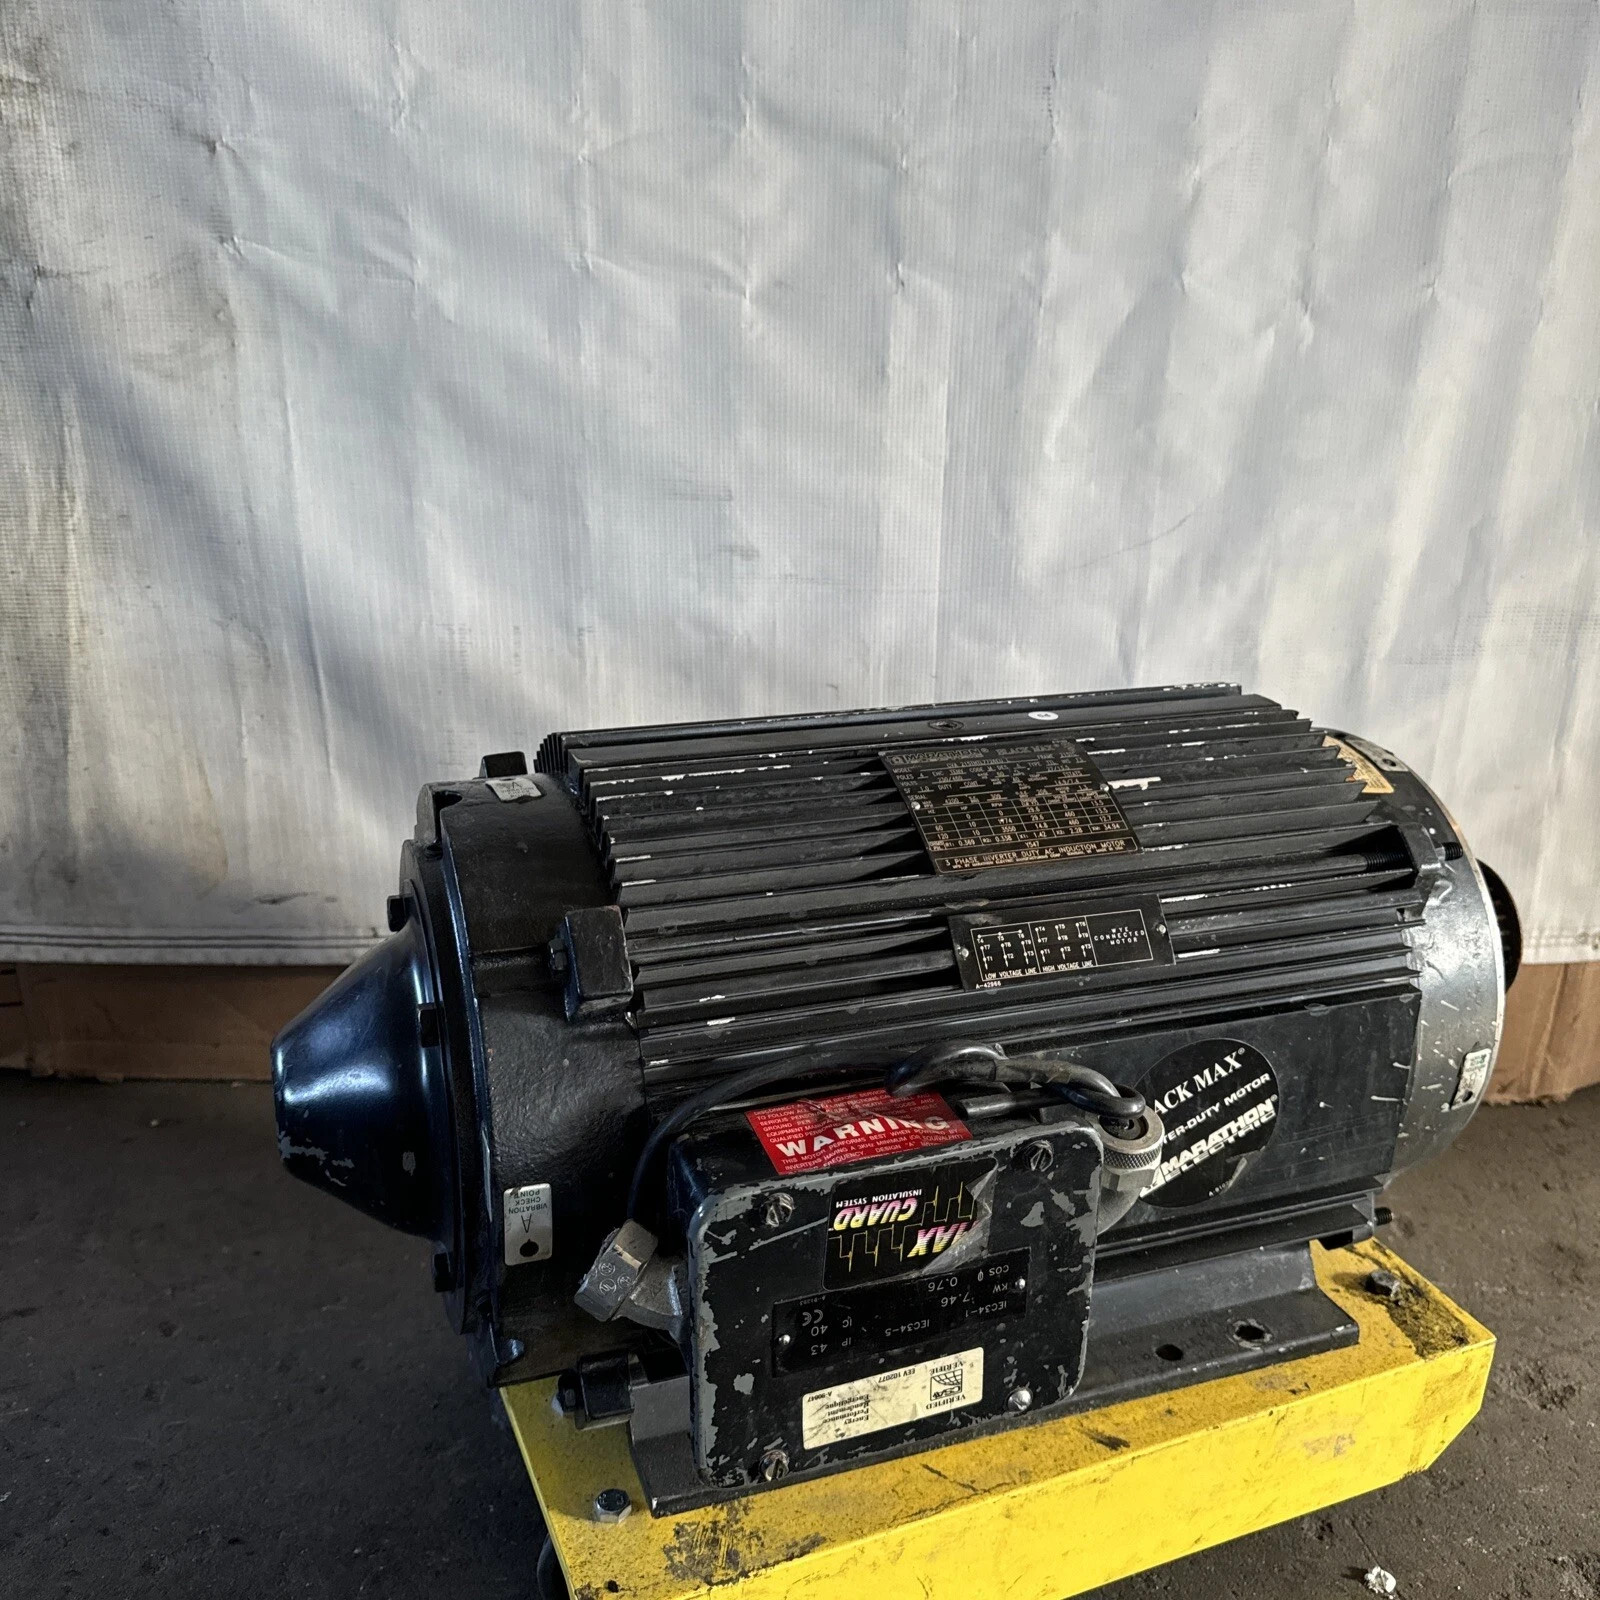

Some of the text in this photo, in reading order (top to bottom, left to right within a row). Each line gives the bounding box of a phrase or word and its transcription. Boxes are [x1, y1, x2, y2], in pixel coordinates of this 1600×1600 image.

[953, 856, 980, 864] PHASE
[981, 851, 1018, 861] INVERTER
[1019, 849, 1041, 857] DUTY
[1056, 843, 1098, 853] INDUCTION
[1098, 839, 1126, 848] MOTOR
[1093, 929, 1145, 941] CONNECTED
[1109, 936, 1138, 945] MOTOR
[998, 968, 1022, 978] VOLTAGE
[1041, 959, 1093, 972] HIGH VOLTAGE LINE
[1154, 1082, 1194, 1116] ACK
[1164, 1073, 1272, 1144] TER-DUTY MOTOR
[760, 1117, 789, 1126] SERIOUS
[762, 1122, 792, 1132] GROUND
[766, 1126, 804, 1138] EQUIPMENT
[770, 1133, 804, 1143] QUALIFIED
[775, 1116, 950, 1156] WARNING
[800, 1149, 826, 1161] MOTOR
[828, 1137, 867, 1150] PERFORMS
[890, 1129, 911, 1137] WHEN
[874, 1144, 902, 1153] DESIGN
[784, 1158, 822, 1171] INVERTERS
[824, 1147, 848, 1160] HAVING
[876, 1136, 908, 1146] MINIMUM
[514, 1188, 539, 1199] POINT
[514, 1196, 540, 1206] CHECK
[835, 1189, 922, 1209] INSULATION SYSTEM
[508, 1202, 548, 1214] VIBRATION
[833, 1198, 919, 1231] GUARD
[520, 1213, 532, 1233] A
[927, 1264, 1010, 1293] COS 0.76
[940, 1282, 1009, 1307] KW 7.46
[964, 1300, 1008, 1318] IEC34-1
[810, 1324, 830, 1338] 40
[884, 1319, 931, 1337] IEC34-5
[810, 1336, 852, 1356] IP 43
[878, 1368, 916, 1383] EEV 102077
[826, 1400, 870, 1418] Rendement
[925, 1394, 966, 1410] VERIFIED
[822, 1408, 870, 1425] Performance
[844, 1414, 870, 1427] Energy
